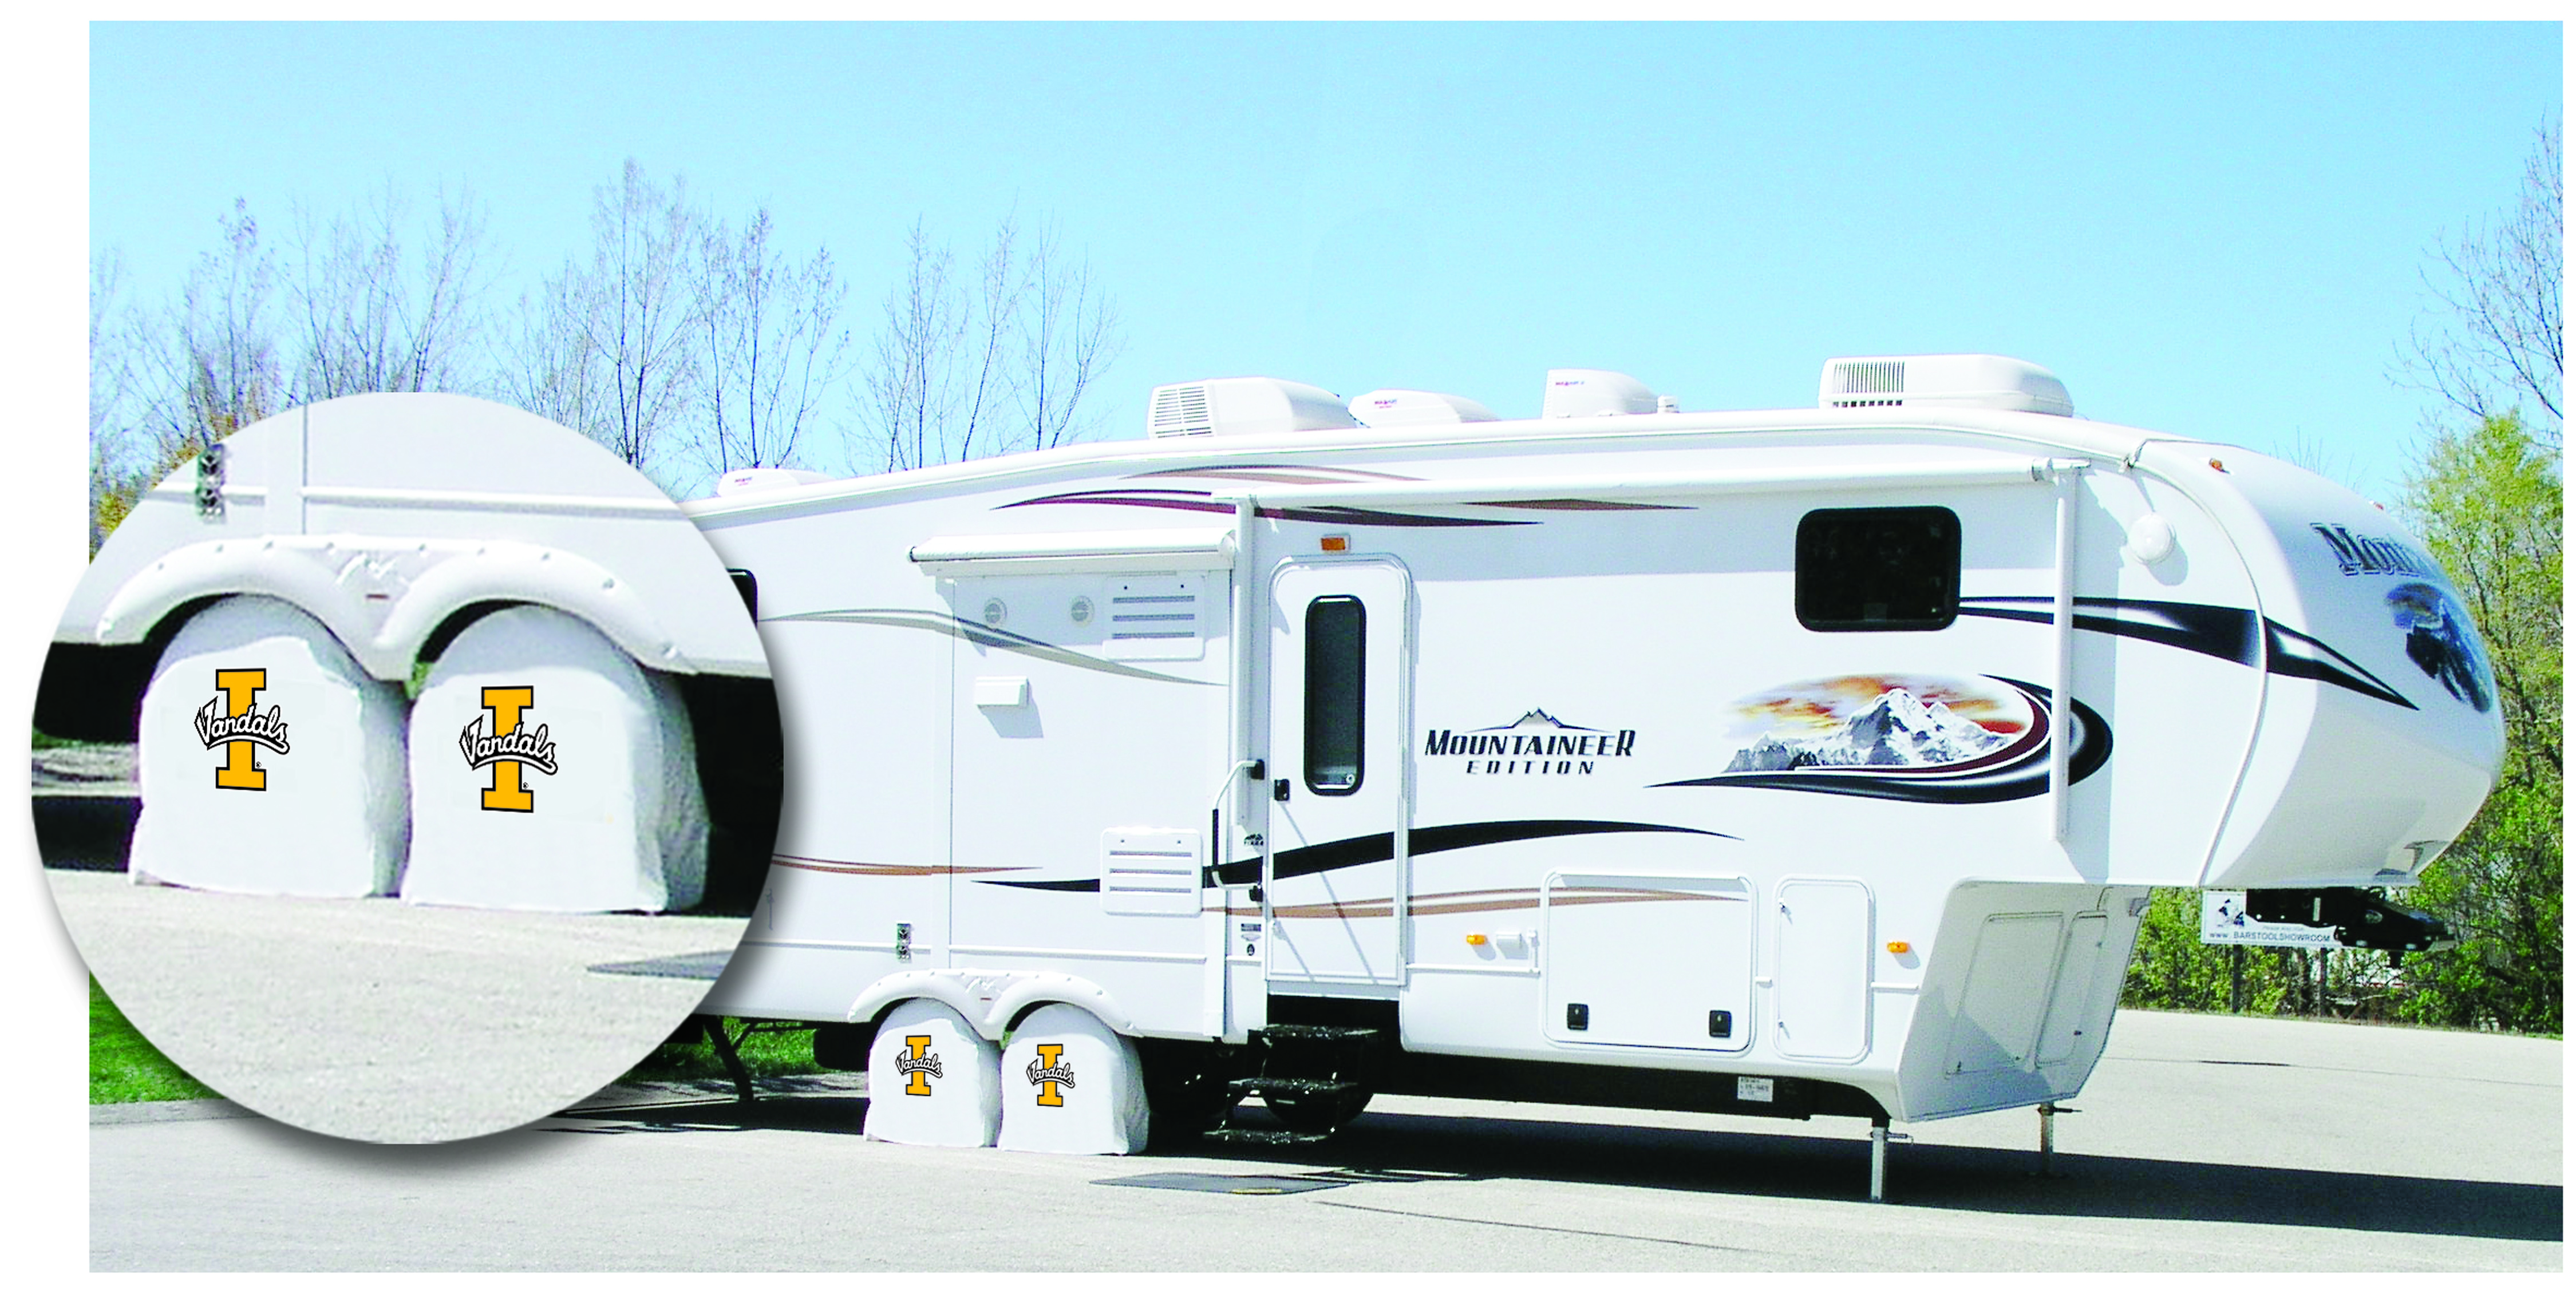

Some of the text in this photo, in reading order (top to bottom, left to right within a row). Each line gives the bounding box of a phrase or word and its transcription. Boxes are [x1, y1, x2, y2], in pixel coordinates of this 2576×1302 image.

[194, 696, 290, 755] Vandals
[459, 714, 559, 775] Vandals
[1424, 729, 1636, 757] MOUNTAINEER
[1466, 760, 1594, 775] EDITION
[895, 1048, 943, 1079] Vandals
[1026, 1058, 1076, 1089] Vandals
